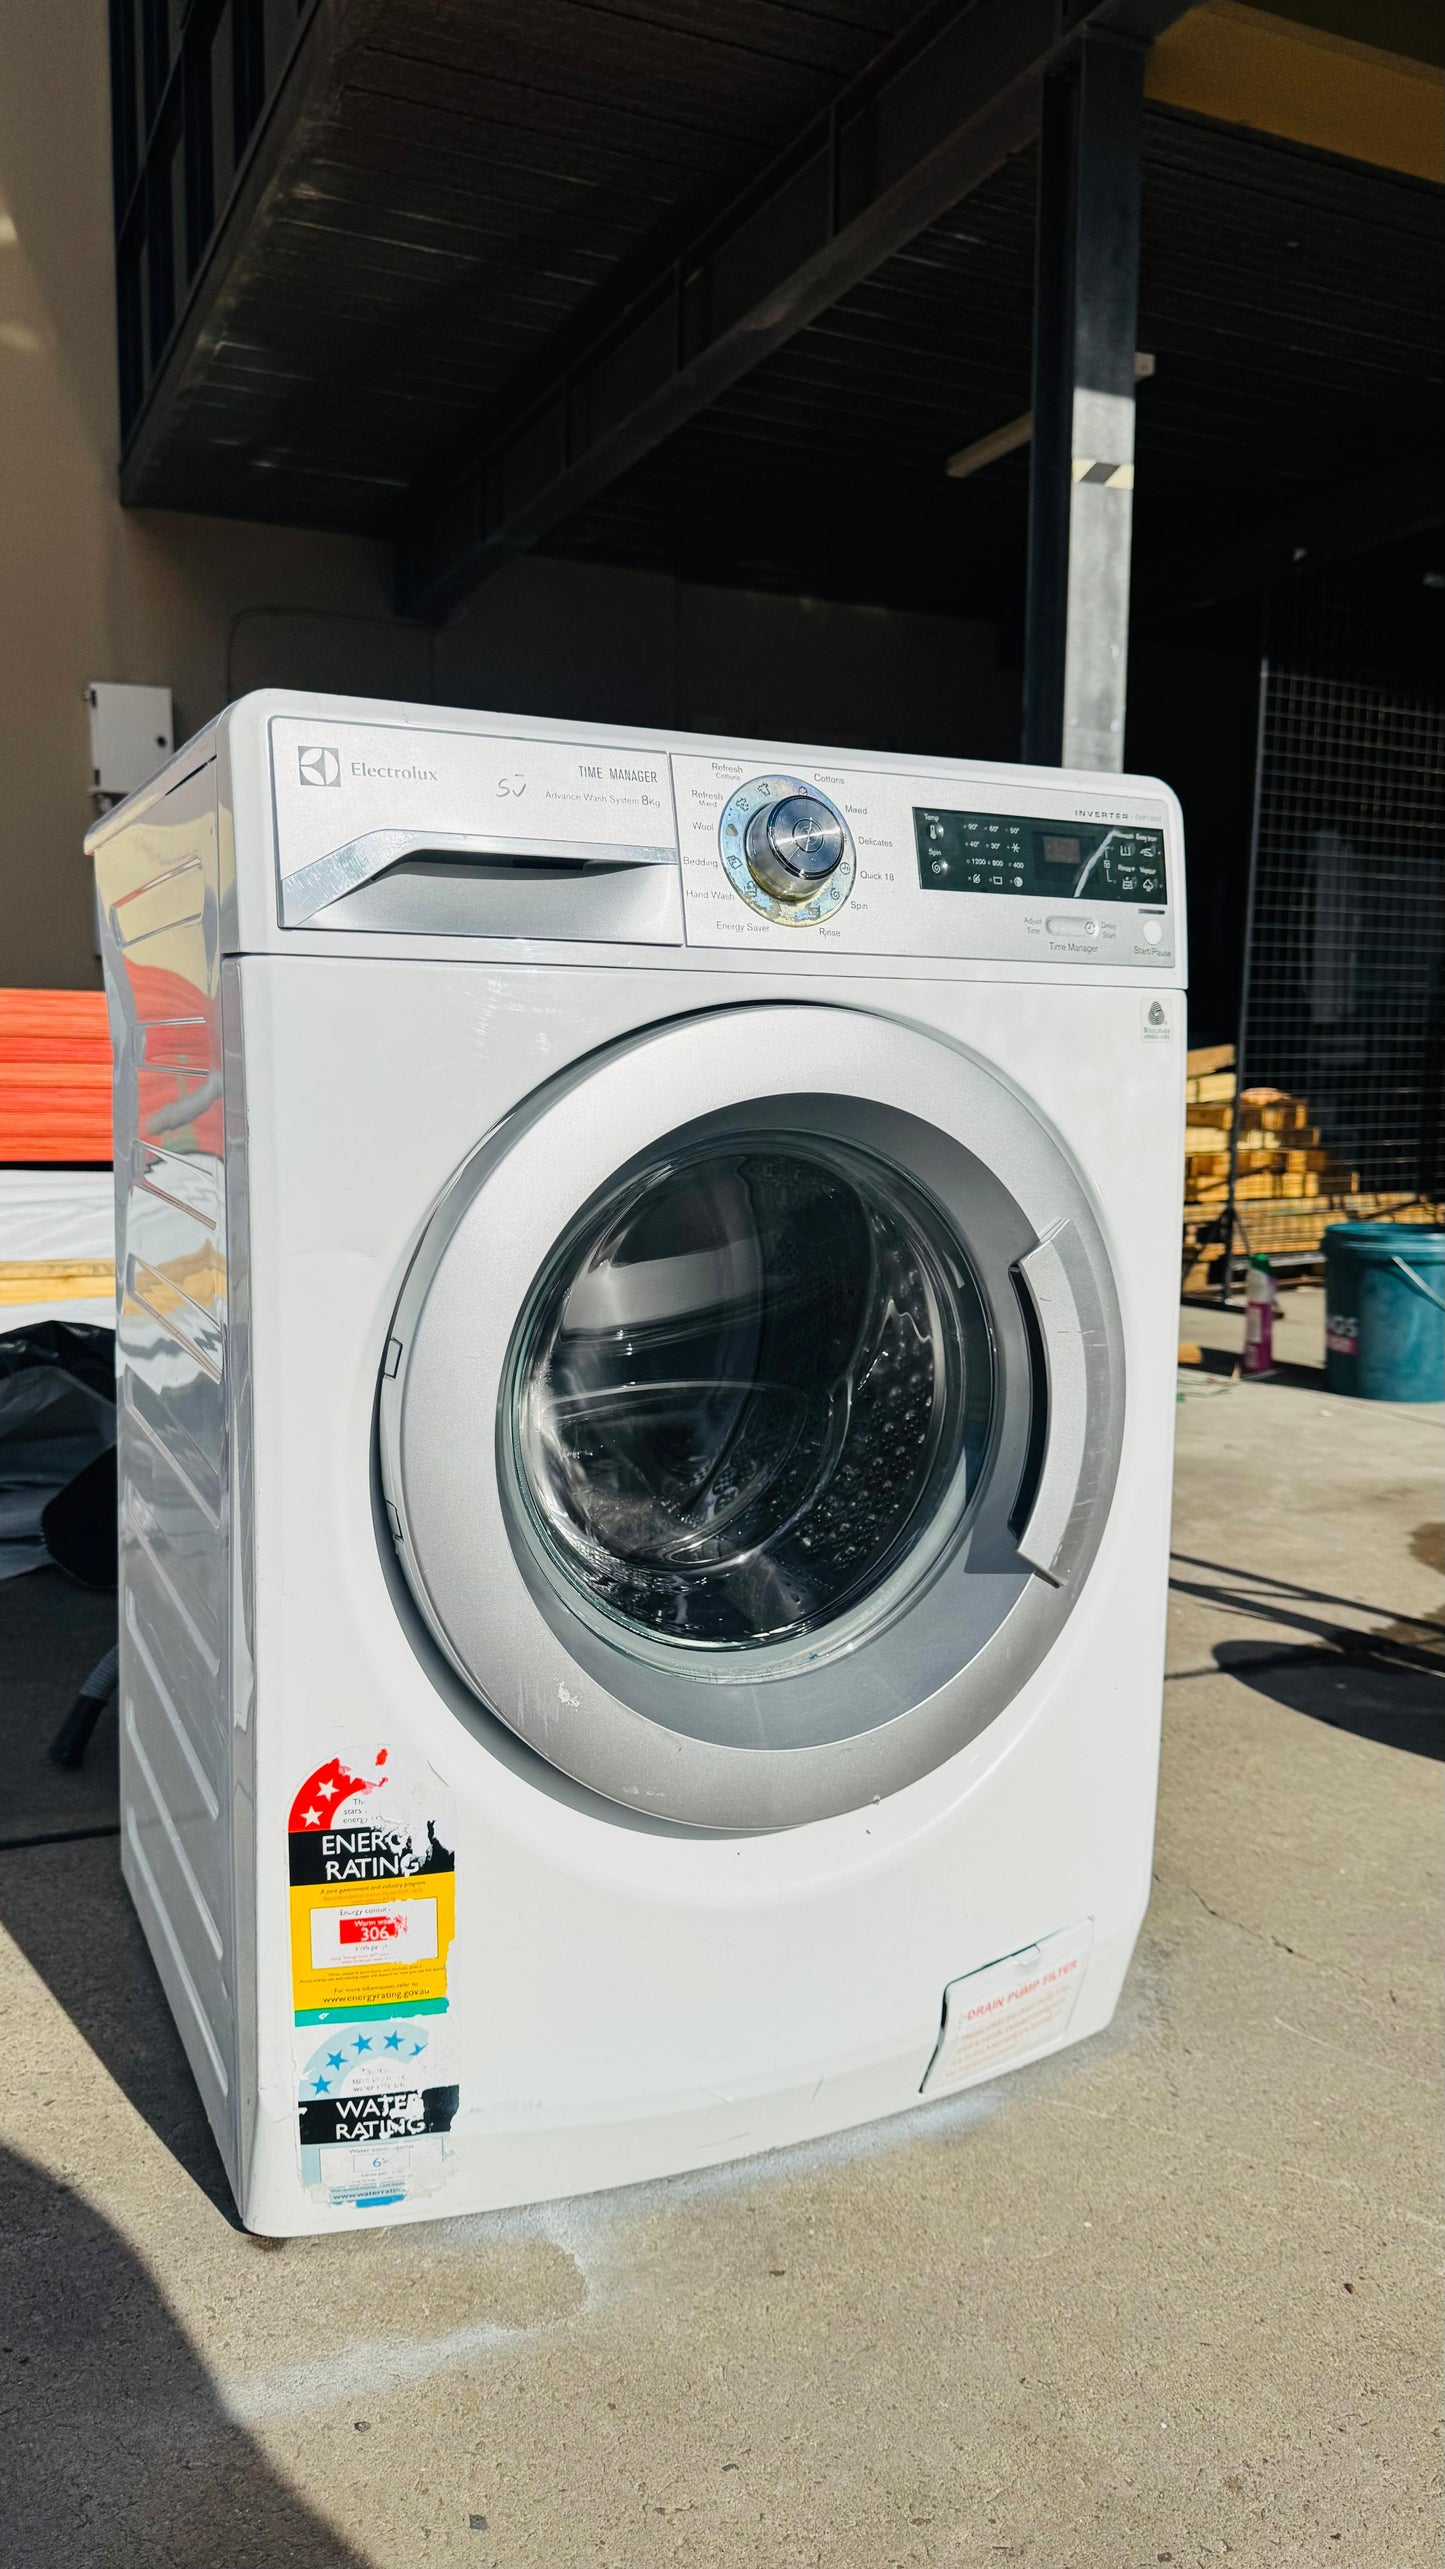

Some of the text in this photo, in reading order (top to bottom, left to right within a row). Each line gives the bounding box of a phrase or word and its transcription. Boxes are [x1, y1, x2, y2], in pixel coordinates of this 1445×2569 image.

[351, 761, 438, 782] Electrolux
[712, 762, 743, 774] Refresh
[578, 765, 658, 784] TIME MANAGER
[814, 774, 845, 785] Cottons
[545, 790, 581, 801] Advance
[584, 793, 607, 803] Wash
[609, 794, 640, 806] System
[691, 790, 724, 801] Refresh
[845, 805, 868, 815] Mixed
[1074, 810, 1129, 819] INVERTER
[924, 812, 940, 822] Temp
[692, 822, 714, 832] Wool
[858, 836, 893, 848] Delicates
[928, 848, 942, 856] Spin
[683, 856, 718, 868] Bedding
[860, 871, 894, 881] Quick 18
[686, 890, 735, 901] Hand Wash
[850, 900, 868, 911] Spin
[716, 921, 770, 932] Energy Saver
[820, 928, 841, 938] Rinse
[1050, 942, 1098, 954] Time Manager
[326, 1853, 420, 1881] RATING
[322, 1988, 430, 2004] www.energyrating.gov.au
[966, 1997, 1004, 2021] DRAIN
[1008, 1980, 1040, 2003] PUMP
[1042, 1960, 1078, 1986] FILTER
[336, 2118, 426, 2141] RATING
